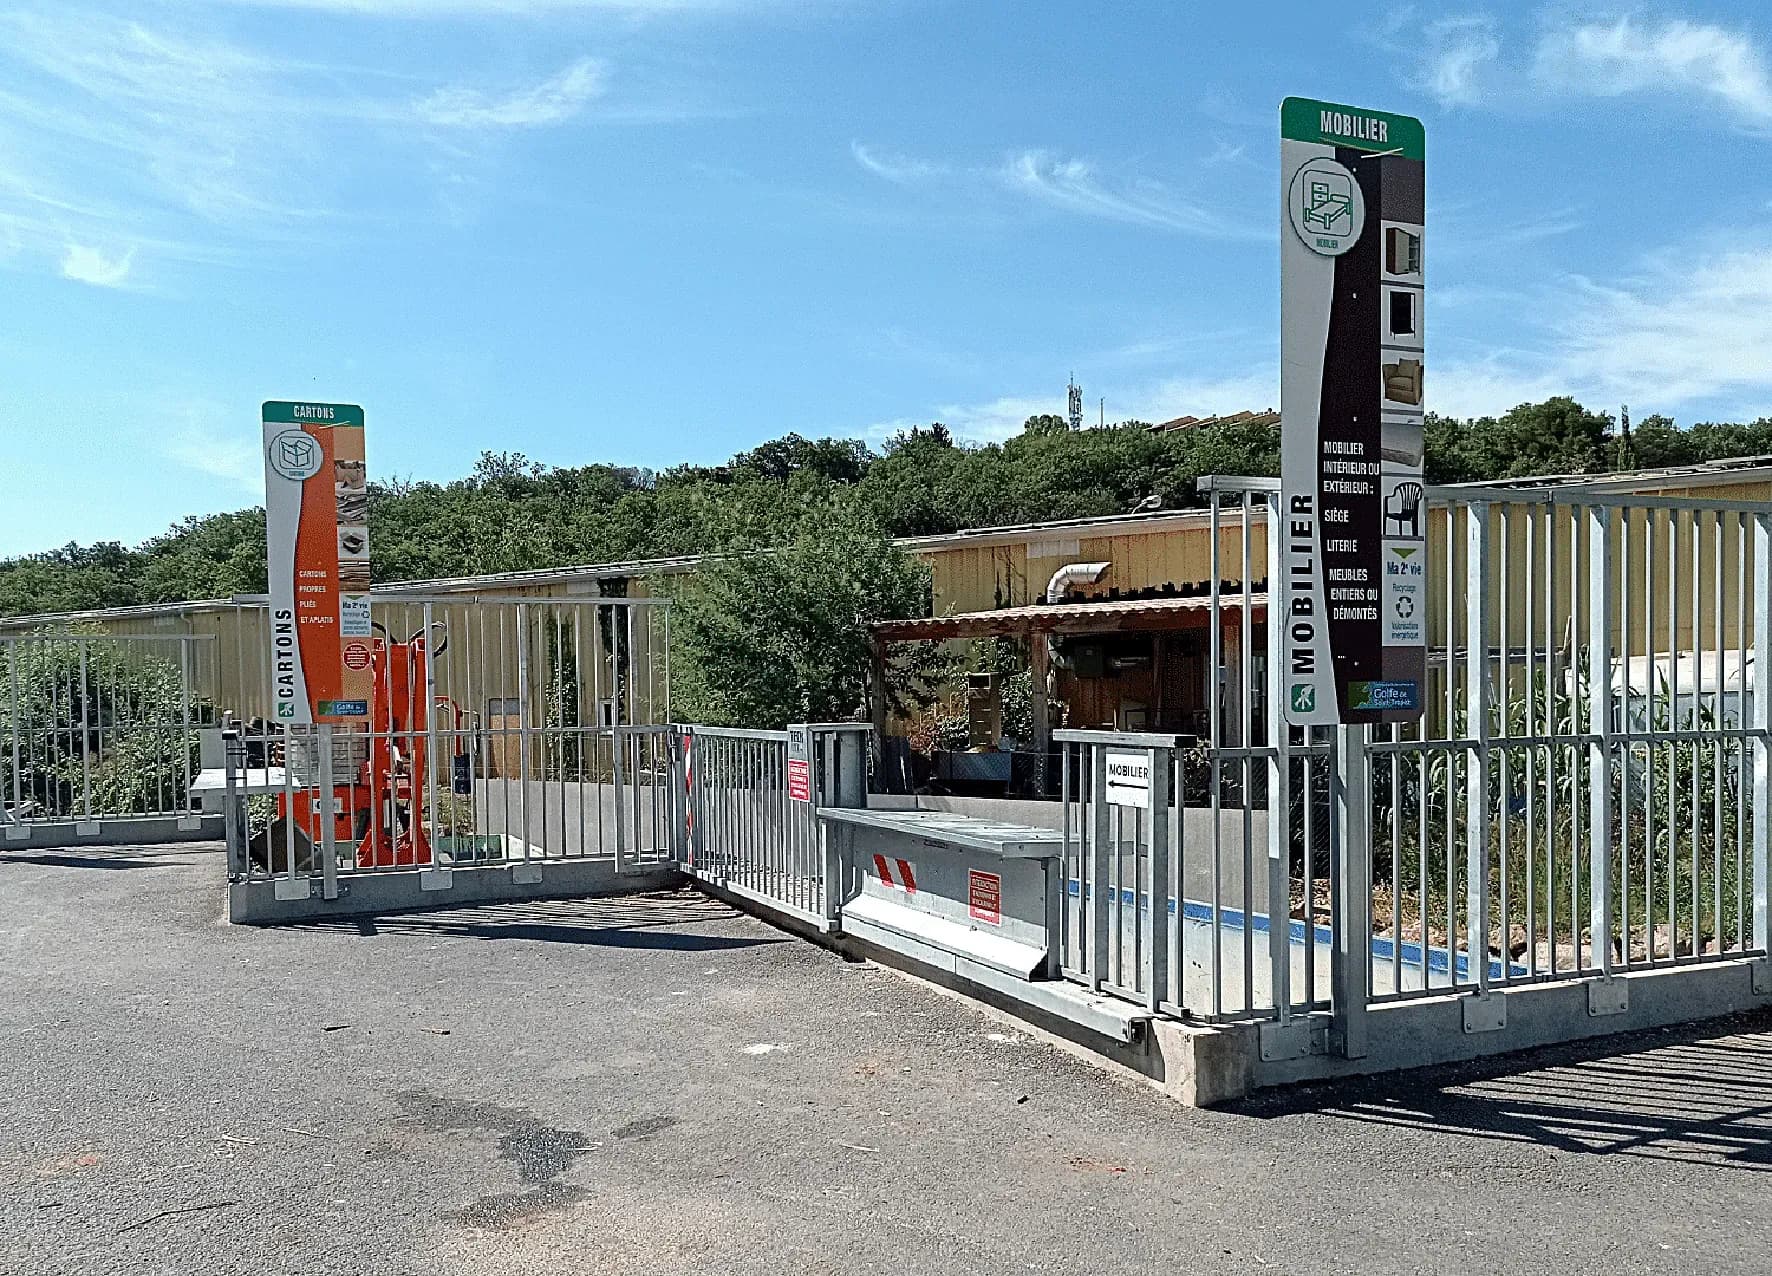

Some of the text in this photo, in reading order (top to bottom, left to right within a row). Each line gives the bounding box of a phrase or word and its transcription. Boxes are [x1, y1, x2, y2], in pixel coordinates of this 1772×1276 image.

[1320, 110, 1388, 142] MOBILIER
[293, 405, 335, 419] CARTONS
[1323, 441, 1364, 455] MOBILIER
[1323, 459, 1380, 476] INTÉRIEUR OU
[1326, 539, 1358, 553] LITERIE
[1328, 568, 1368, 581] MEUBLES
[1410, 561, 1422, 575] vie
[1290, 494, 1315, 675] MOBILIER
[1330, 587, 1378, 601] ENTIERS OU
[1333, 606, 1378, 620] DÉMONTÉS
[275, 609, 294, 698] CARTONS
[1373, 688, 1399, 698] Golfe
[1108, 763, 1149, 779] MOBILIER
